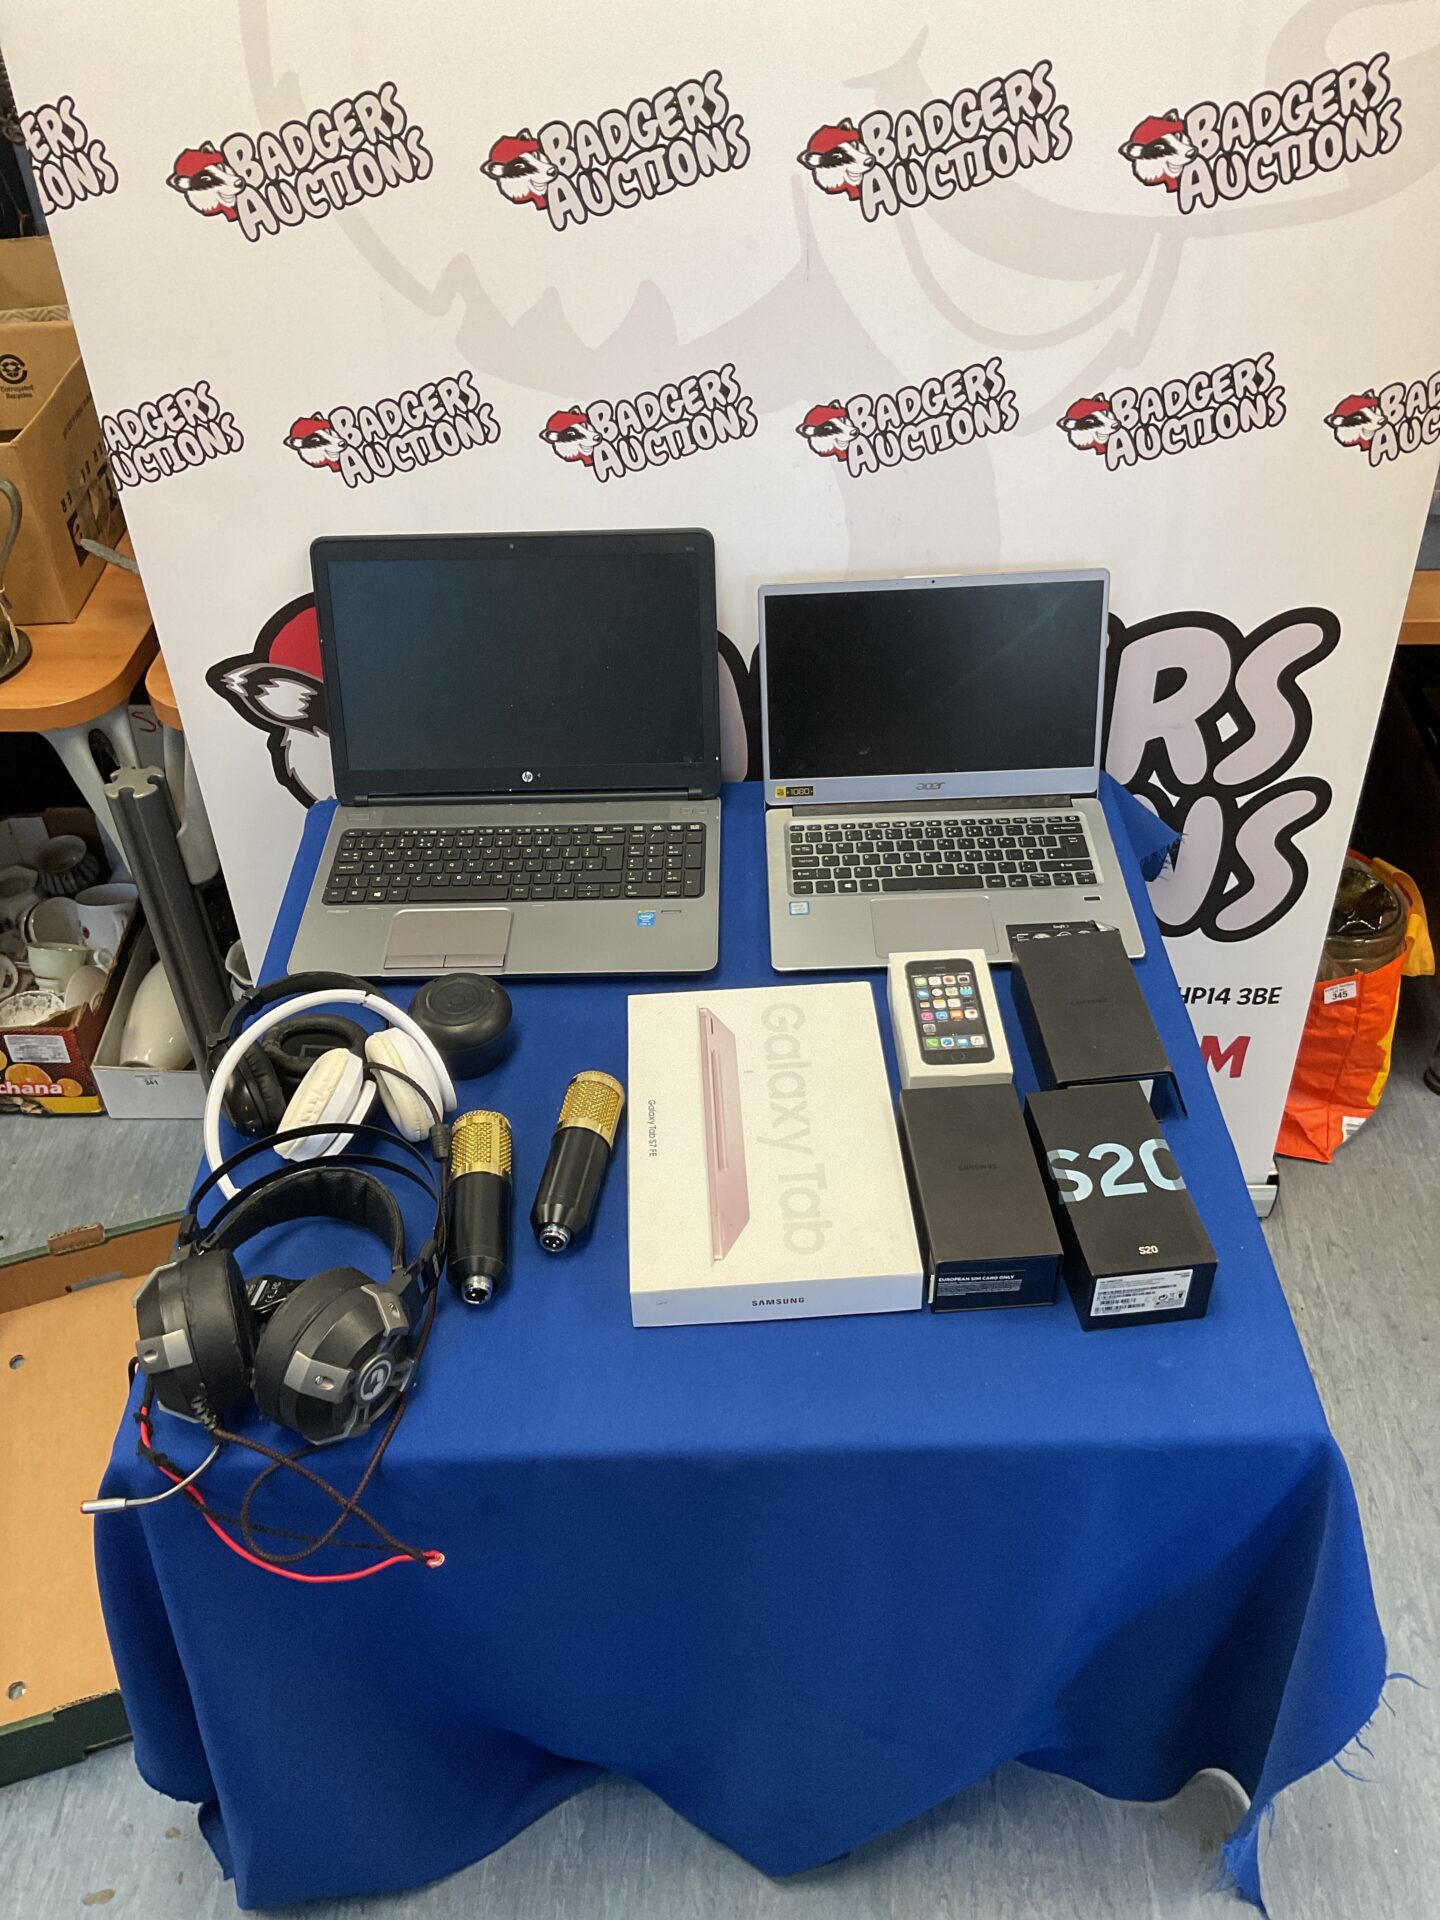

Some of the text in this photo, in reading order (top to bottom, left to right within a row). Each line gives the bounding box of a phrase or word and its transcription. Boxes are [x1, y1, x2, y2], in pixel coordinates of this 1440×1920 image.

[220, 82, 407, 188] BADGERS
[540, 70, 727, 175] BADGERS
[859, 59, 1055, 165] BADGERS
[1186, 51, 1392, 158] BADGERS
[236, 126, 433, 243] AUCTIONS
[547, 115, 750, 231] AUCTIONS
[860, 105, 1073, 222] AUCTIONS
[1177, 97, 1402, 215] AUCTIONS
[329, 370, 480, 447] BADGERS
[589, 363, 742, 443] BADGERS
[845, 356, 1003, 438] BADGERS
[846, 390, 1019, 478] AUCTIONS
[1105, 385, 1286, 472] AUCTIONS
[1111, 352, 1275, 436] BADGERS
[108, 412, 244, 491] UCTIONS
[339, 404, 500, 488] AUCTIONS
[593, 397, 758, 483] AUCTIONS
[1101, 607, 1341, 795] RS
[1236, 986, 1283, 1005] 3BE
[1332, 991, 1348, 1000] 345
[647, 1099, 658, 1157] Galaxy Tab S7 FE
[757, 1003, 834, 1255] Galaxy Tab
[1047, 1138, 1187, 1205] S20
[1138, 1245, 1159, 1255] S20
[751, 1296, 805, 1307] SAMSUNG
